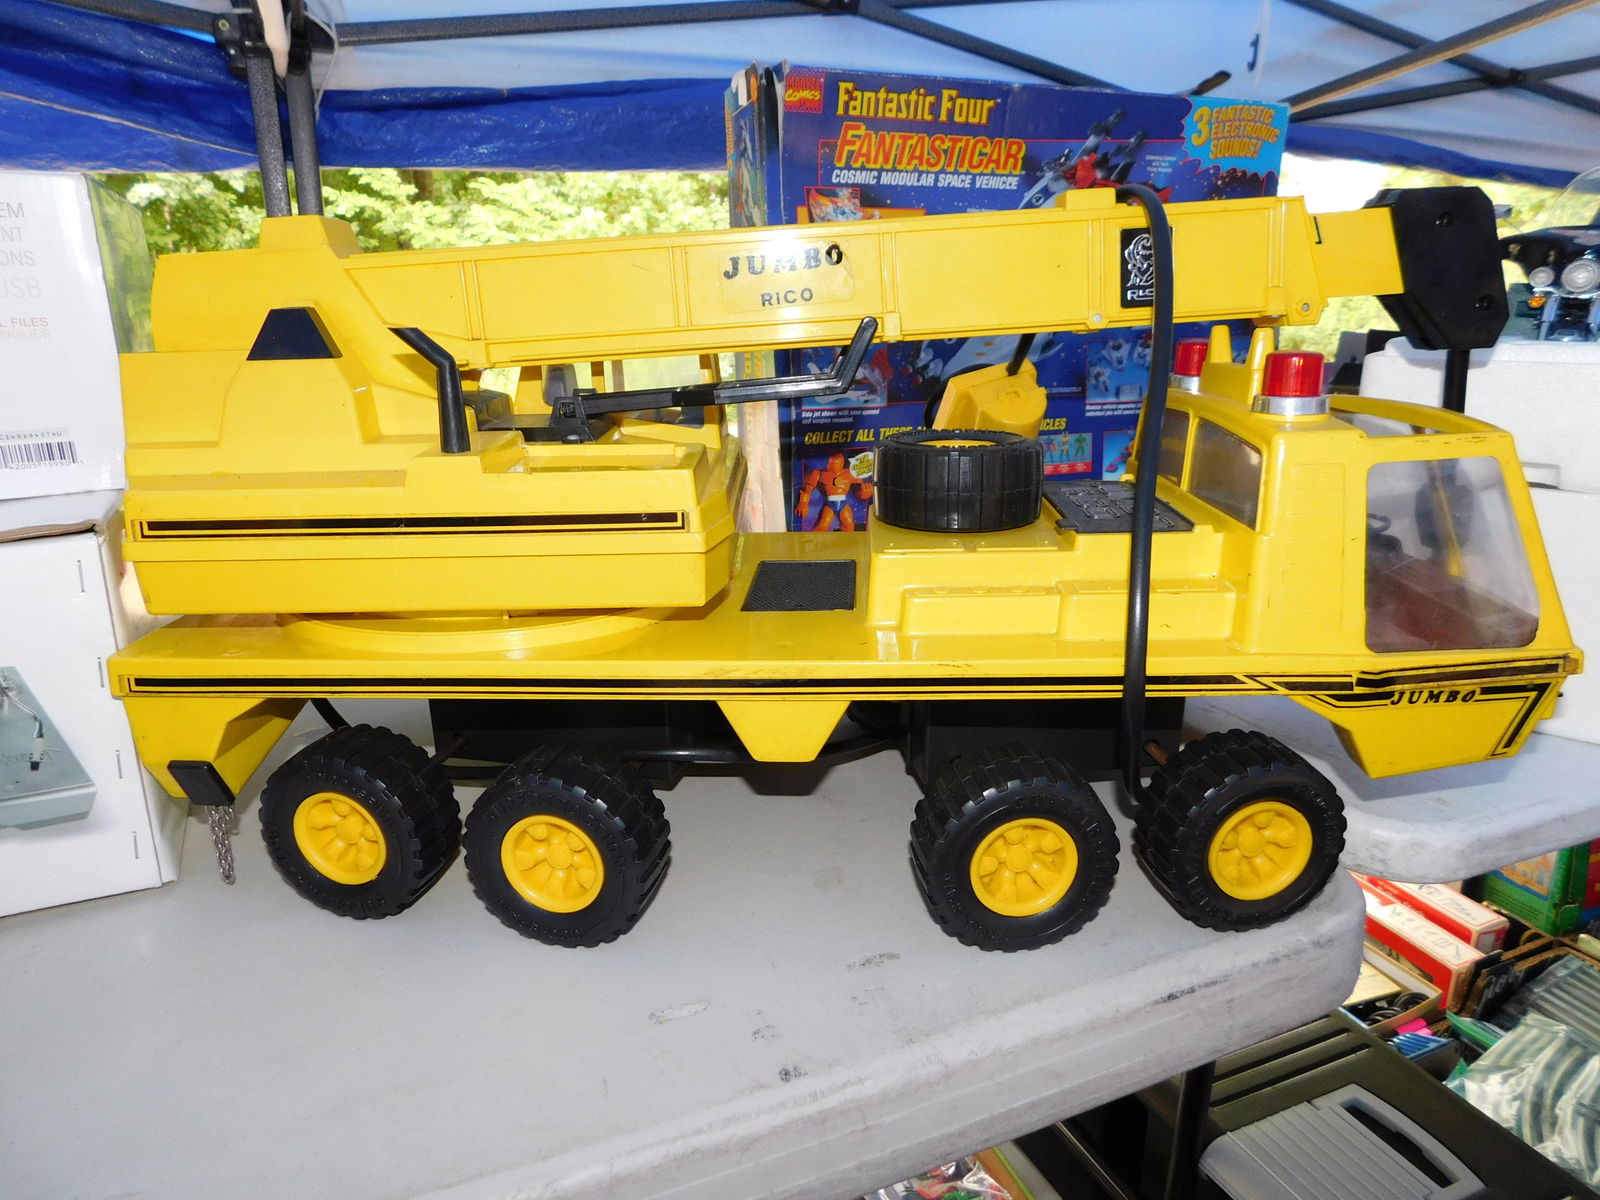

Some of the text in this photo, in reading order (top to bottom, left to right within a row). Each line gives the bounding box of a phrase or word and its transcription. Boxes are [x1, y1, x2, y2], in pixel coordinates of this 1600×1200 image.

[836, 81, 995, 126] Fantastic Four
[1191, 104, 1276, 146] 3 FANTASTIC
[1210, 121, 1281, 143] ELECTRONIC
[834, 121, 1026, 175] FANTASTICAR
[1209, 138, 1263, 160] SOUNDS!
[832, 169, 1020, 190] COSMIC MODULAR SPACE VEHICLE
[723, 244, 844, 280] JUMBO
[760, 288, 814, 307] RICO
[11, 317, 49, 328] FILES
[804, 429, 854, 445] COLLECT
[856, 428, 875, 442] ALL
[1390, 689, 1477, 705] JUMBO
